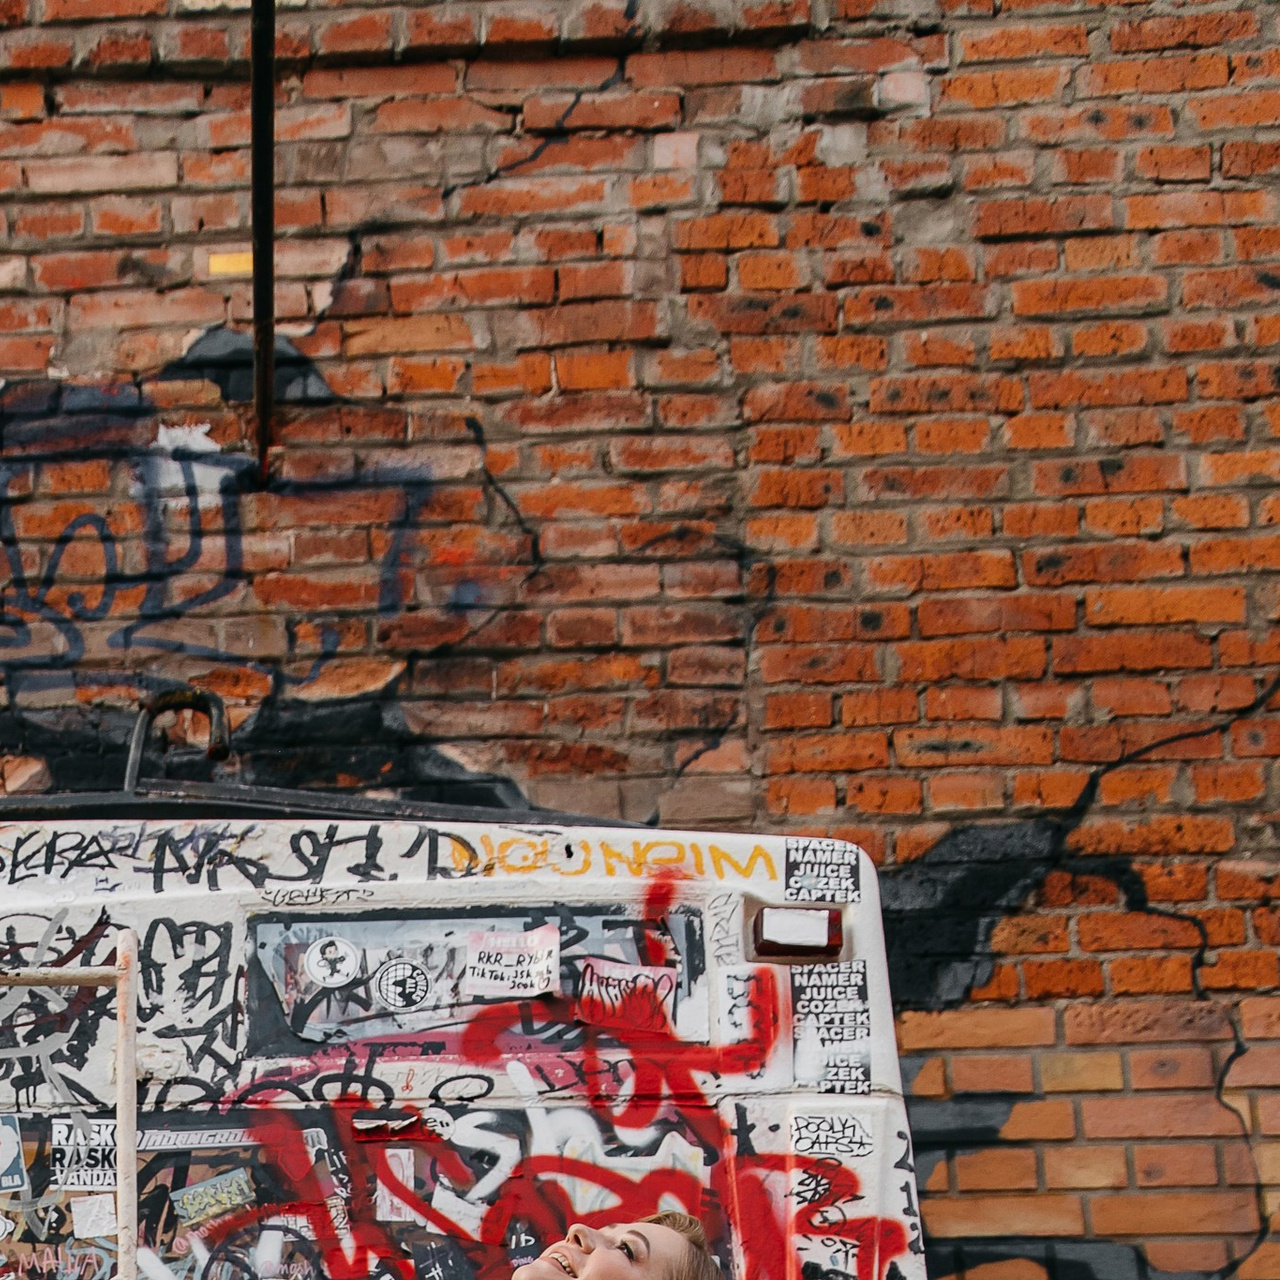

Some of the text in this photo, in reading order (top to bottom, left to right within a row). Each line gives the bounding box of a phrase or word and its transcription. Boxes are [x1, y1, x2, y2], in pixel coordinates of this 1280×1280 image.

[789, 850, 857, 863] NAMER
[794, 863, 851, 877] JUICE
[785, 889, 861, 902] CAPTEK
[794, 973, 864, 987] NAMER
[801, 987, 859, 1000] JUICE
[793, 1013, 870, 1026] CAPTEK
[51, 1124, 118, 1146] RASK
[51, 1148, 118, 1169] RASK
